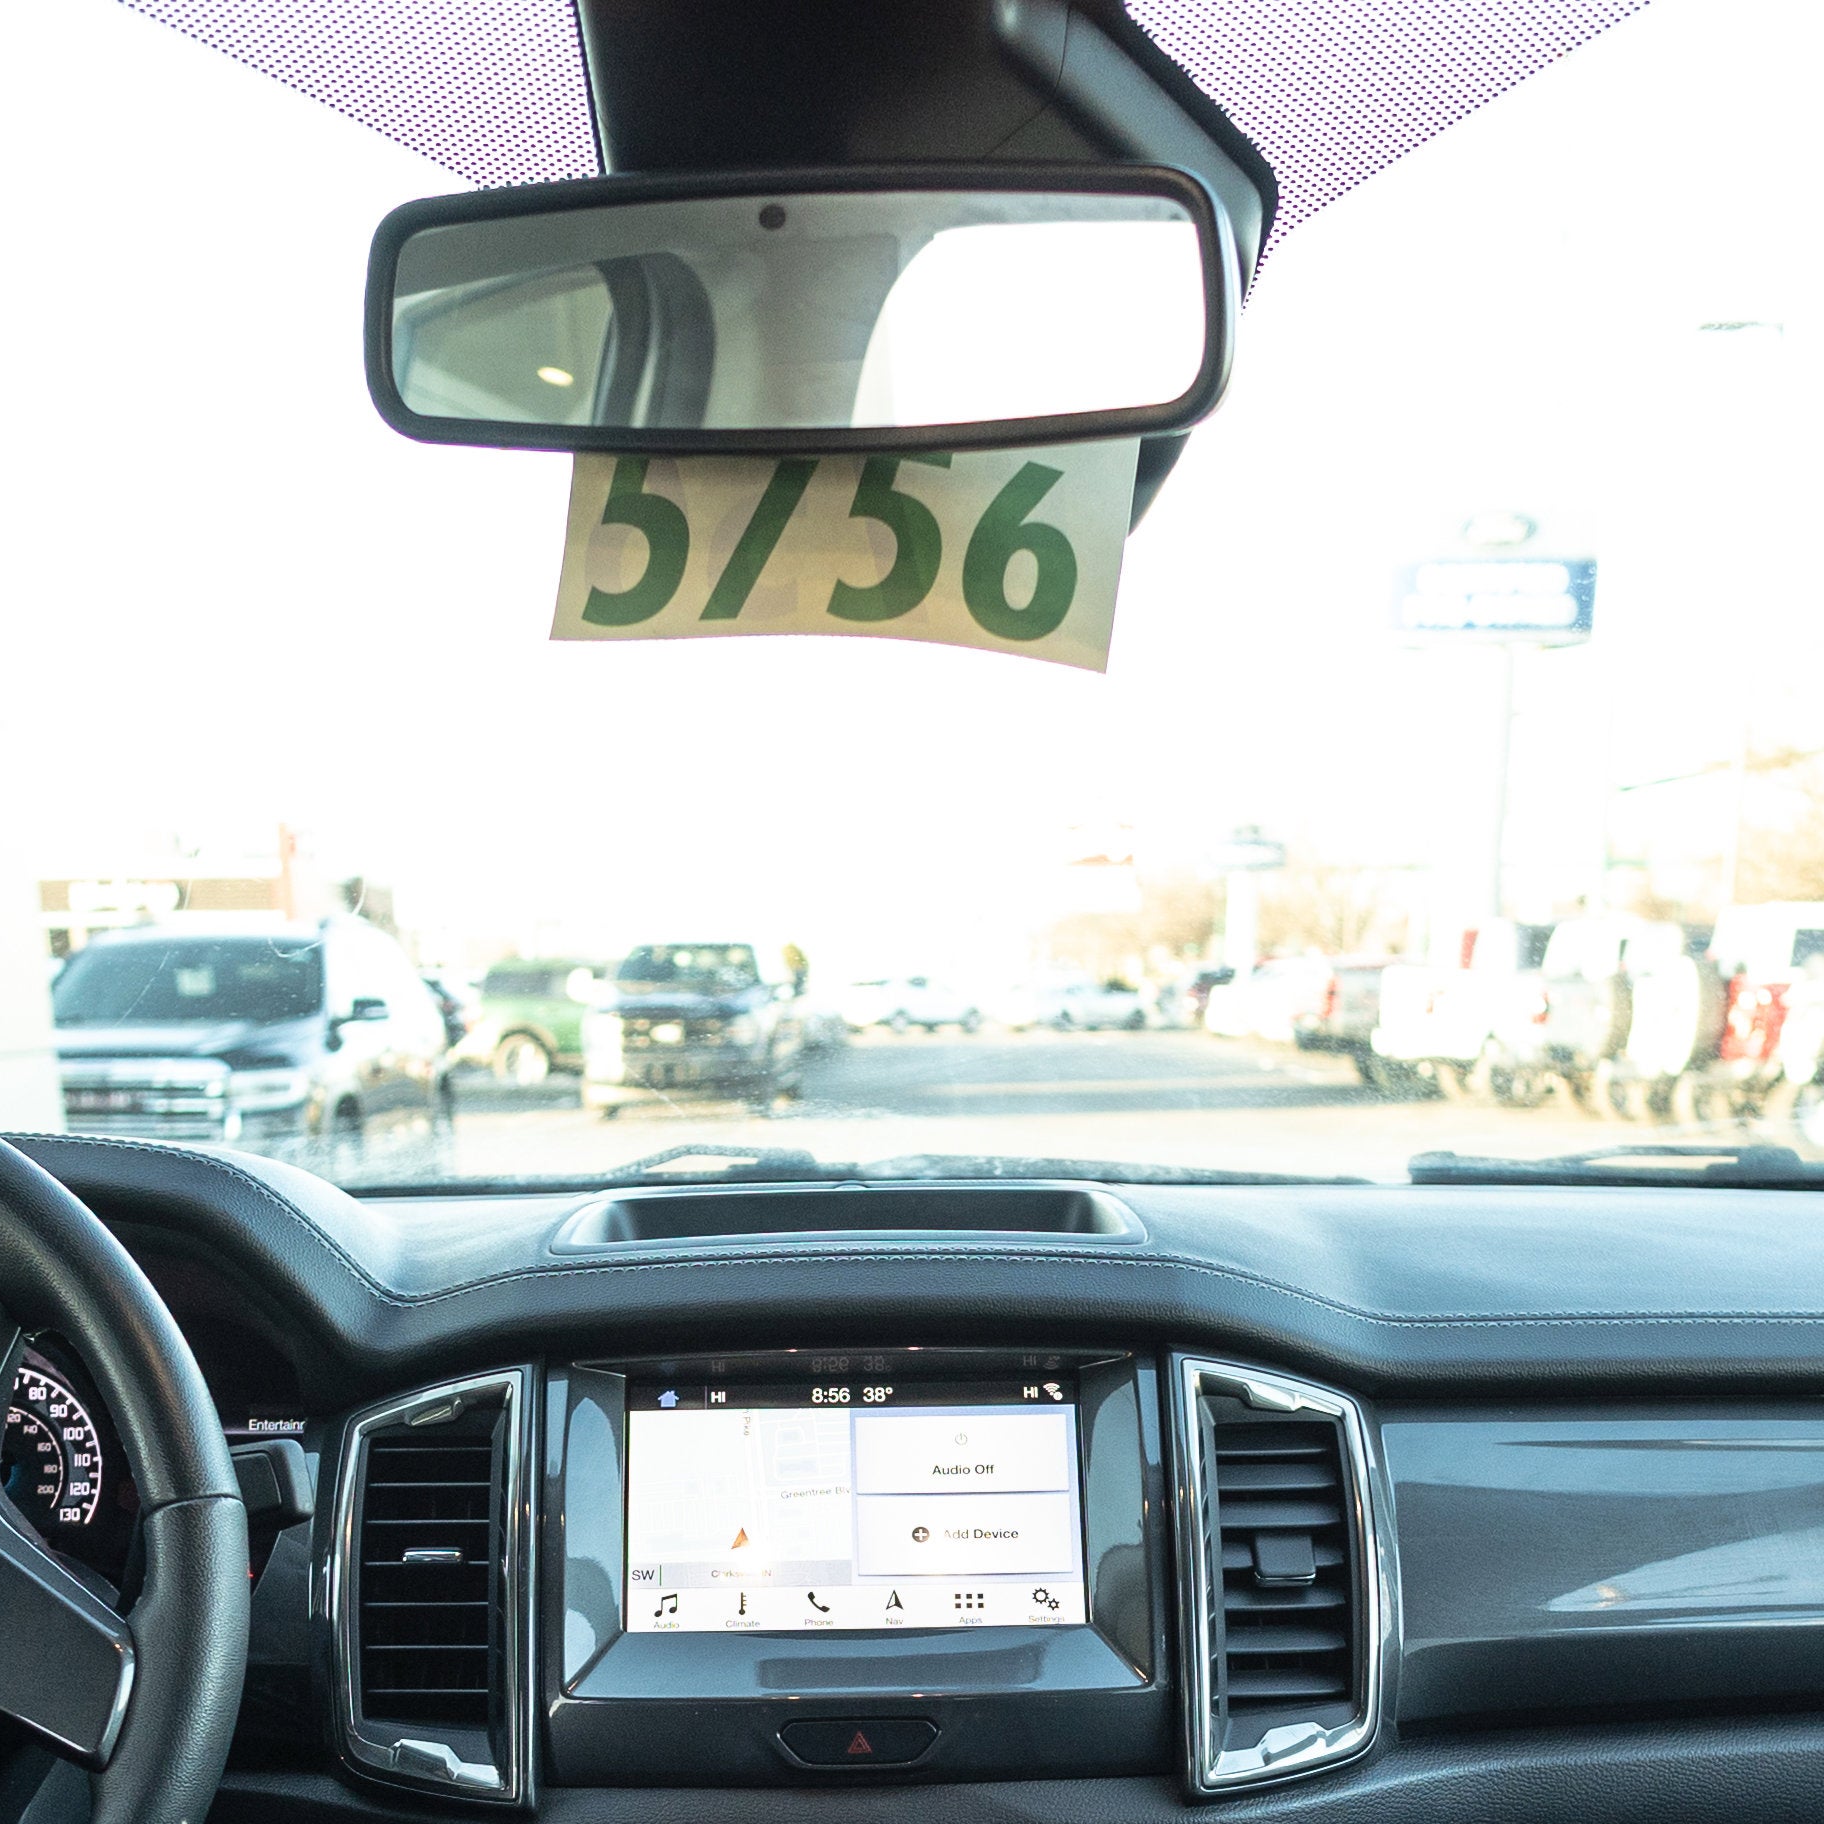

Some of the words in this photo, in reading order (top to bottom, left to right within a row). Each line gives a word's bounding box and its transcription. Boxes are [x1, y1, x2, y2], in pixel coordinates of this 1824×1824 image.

[28, 1387, 47, 1400] 80
[710, 1391, 726, 1403] HI
[811, 1387, 851, 1404] 8:56
[862, 1386, 894, 1402] 38°
[1023, 1386, 1039, 1399] HI
[49, 1404, 68, 1417] 90
[23, 1425, 38, 1435] 140
[63, 1427, 85, 1440] 100
[74, 1454, 91, 1467] 110
[932, 1464, 971, 1476] Audio
[974, 1464, 995, 1475] Off
[37, 1485, 55, 1495] 200
[69, 1482, 90, 1495] 120
[780, 1488, 832, 1500] Greentree
[59, 1508, 81, 1521] 130
[944, 1529, 969, 1540] Add
[973, 1528, 1020, 1540] Device
[631, 1569, 655, 1581] SW
[653, 1620, 680, 1630] Audio
[725, 1619, 761, 1629] Climate
[804, 1618, 834, 1627] Phone
[885, 1617, 904, 1625] Nav
[958, 1616, 983, 1625] Apps
[1028, 1615, 1066, 1624] Settings
